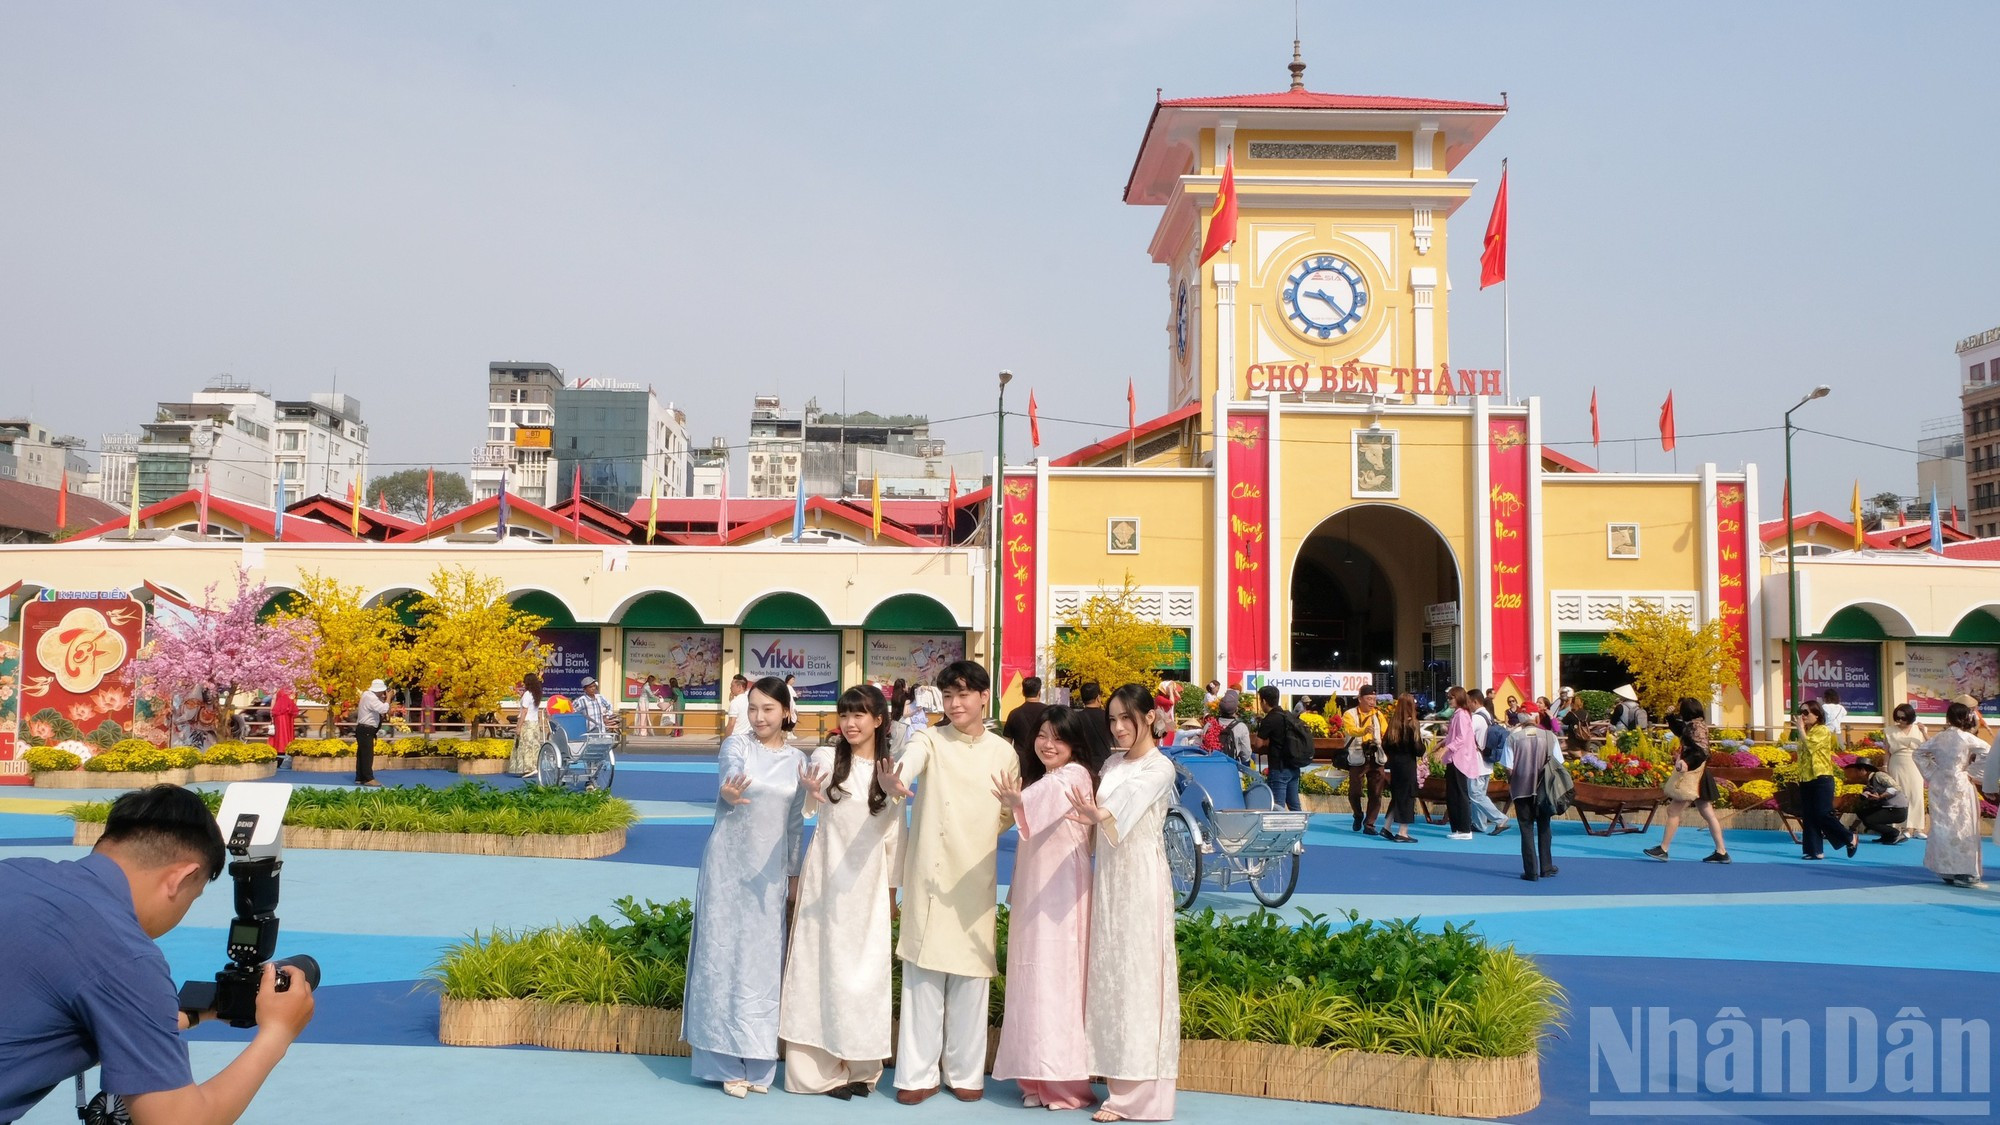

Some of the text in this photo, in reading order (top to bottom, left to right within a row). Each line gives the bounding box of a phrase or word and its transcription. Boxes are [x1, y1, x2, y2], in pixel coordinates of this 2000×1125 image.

[566, 377, 617, 389] AVANTI
[1245, 358, 1502, 396] CHỢ BẾN THÀNH
[1232, 482, 1261, 499] Chúc
[1490, 483, 1525, 517] Happy
[1231, 514, 1264, 543] Mừng
[1721, 544, 1738, 561] Vui
[58, 590, 98, 600] KHANG
[1494, 594, 1521, 609] 2026
[59, 628, 110, 678] Tết
[565, 652, 585, 660] Digital
[751, 639, 805, 669] Vikki
[807, 655, 827, 663] Digital
[565, 658, 590, 667] Bank
[807, 661, 831, 669] Bank
[1845, 666, 1864, 674] Digital
[1845, 673, 1869, 681] Bank
[1267, 678, 1309, 688] KHANG
[1312, 674, 1340, 688] ĐIỀN
